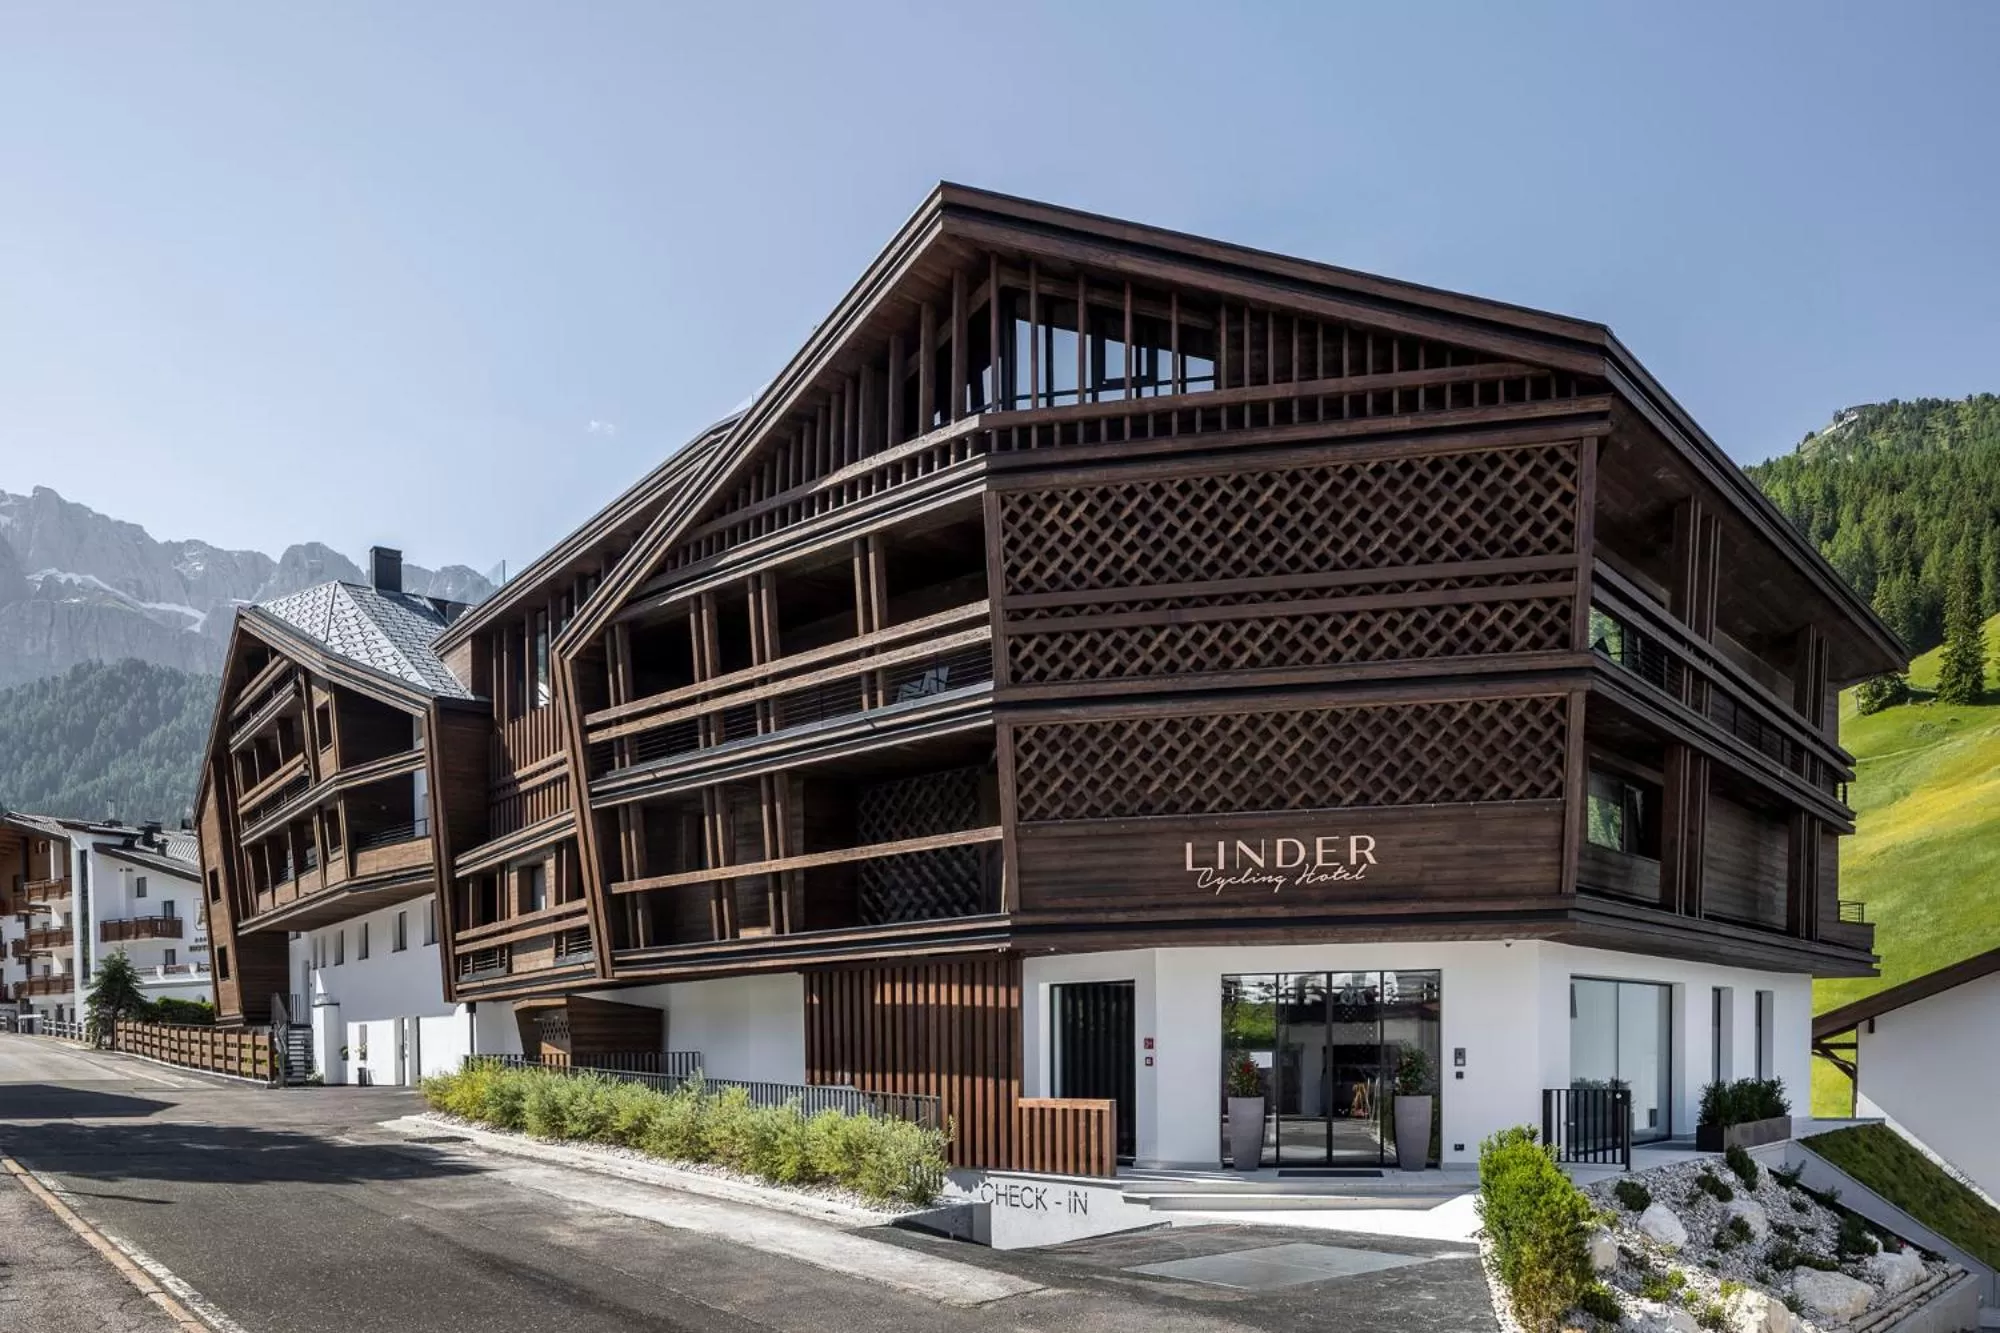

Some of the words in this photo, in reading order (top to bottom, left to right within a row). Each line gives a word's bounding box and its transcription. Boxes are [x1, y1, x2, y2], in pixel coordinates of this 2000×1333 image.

[1185, 835, 1378, 871] LINDER
[1197, 867, 1287, 895] Cycling
[1295, 864, 1365, 886] Hotel
[981, 1183, 1048, 1211] CHECK
[1068, 1190, 1088, 1216] IN
